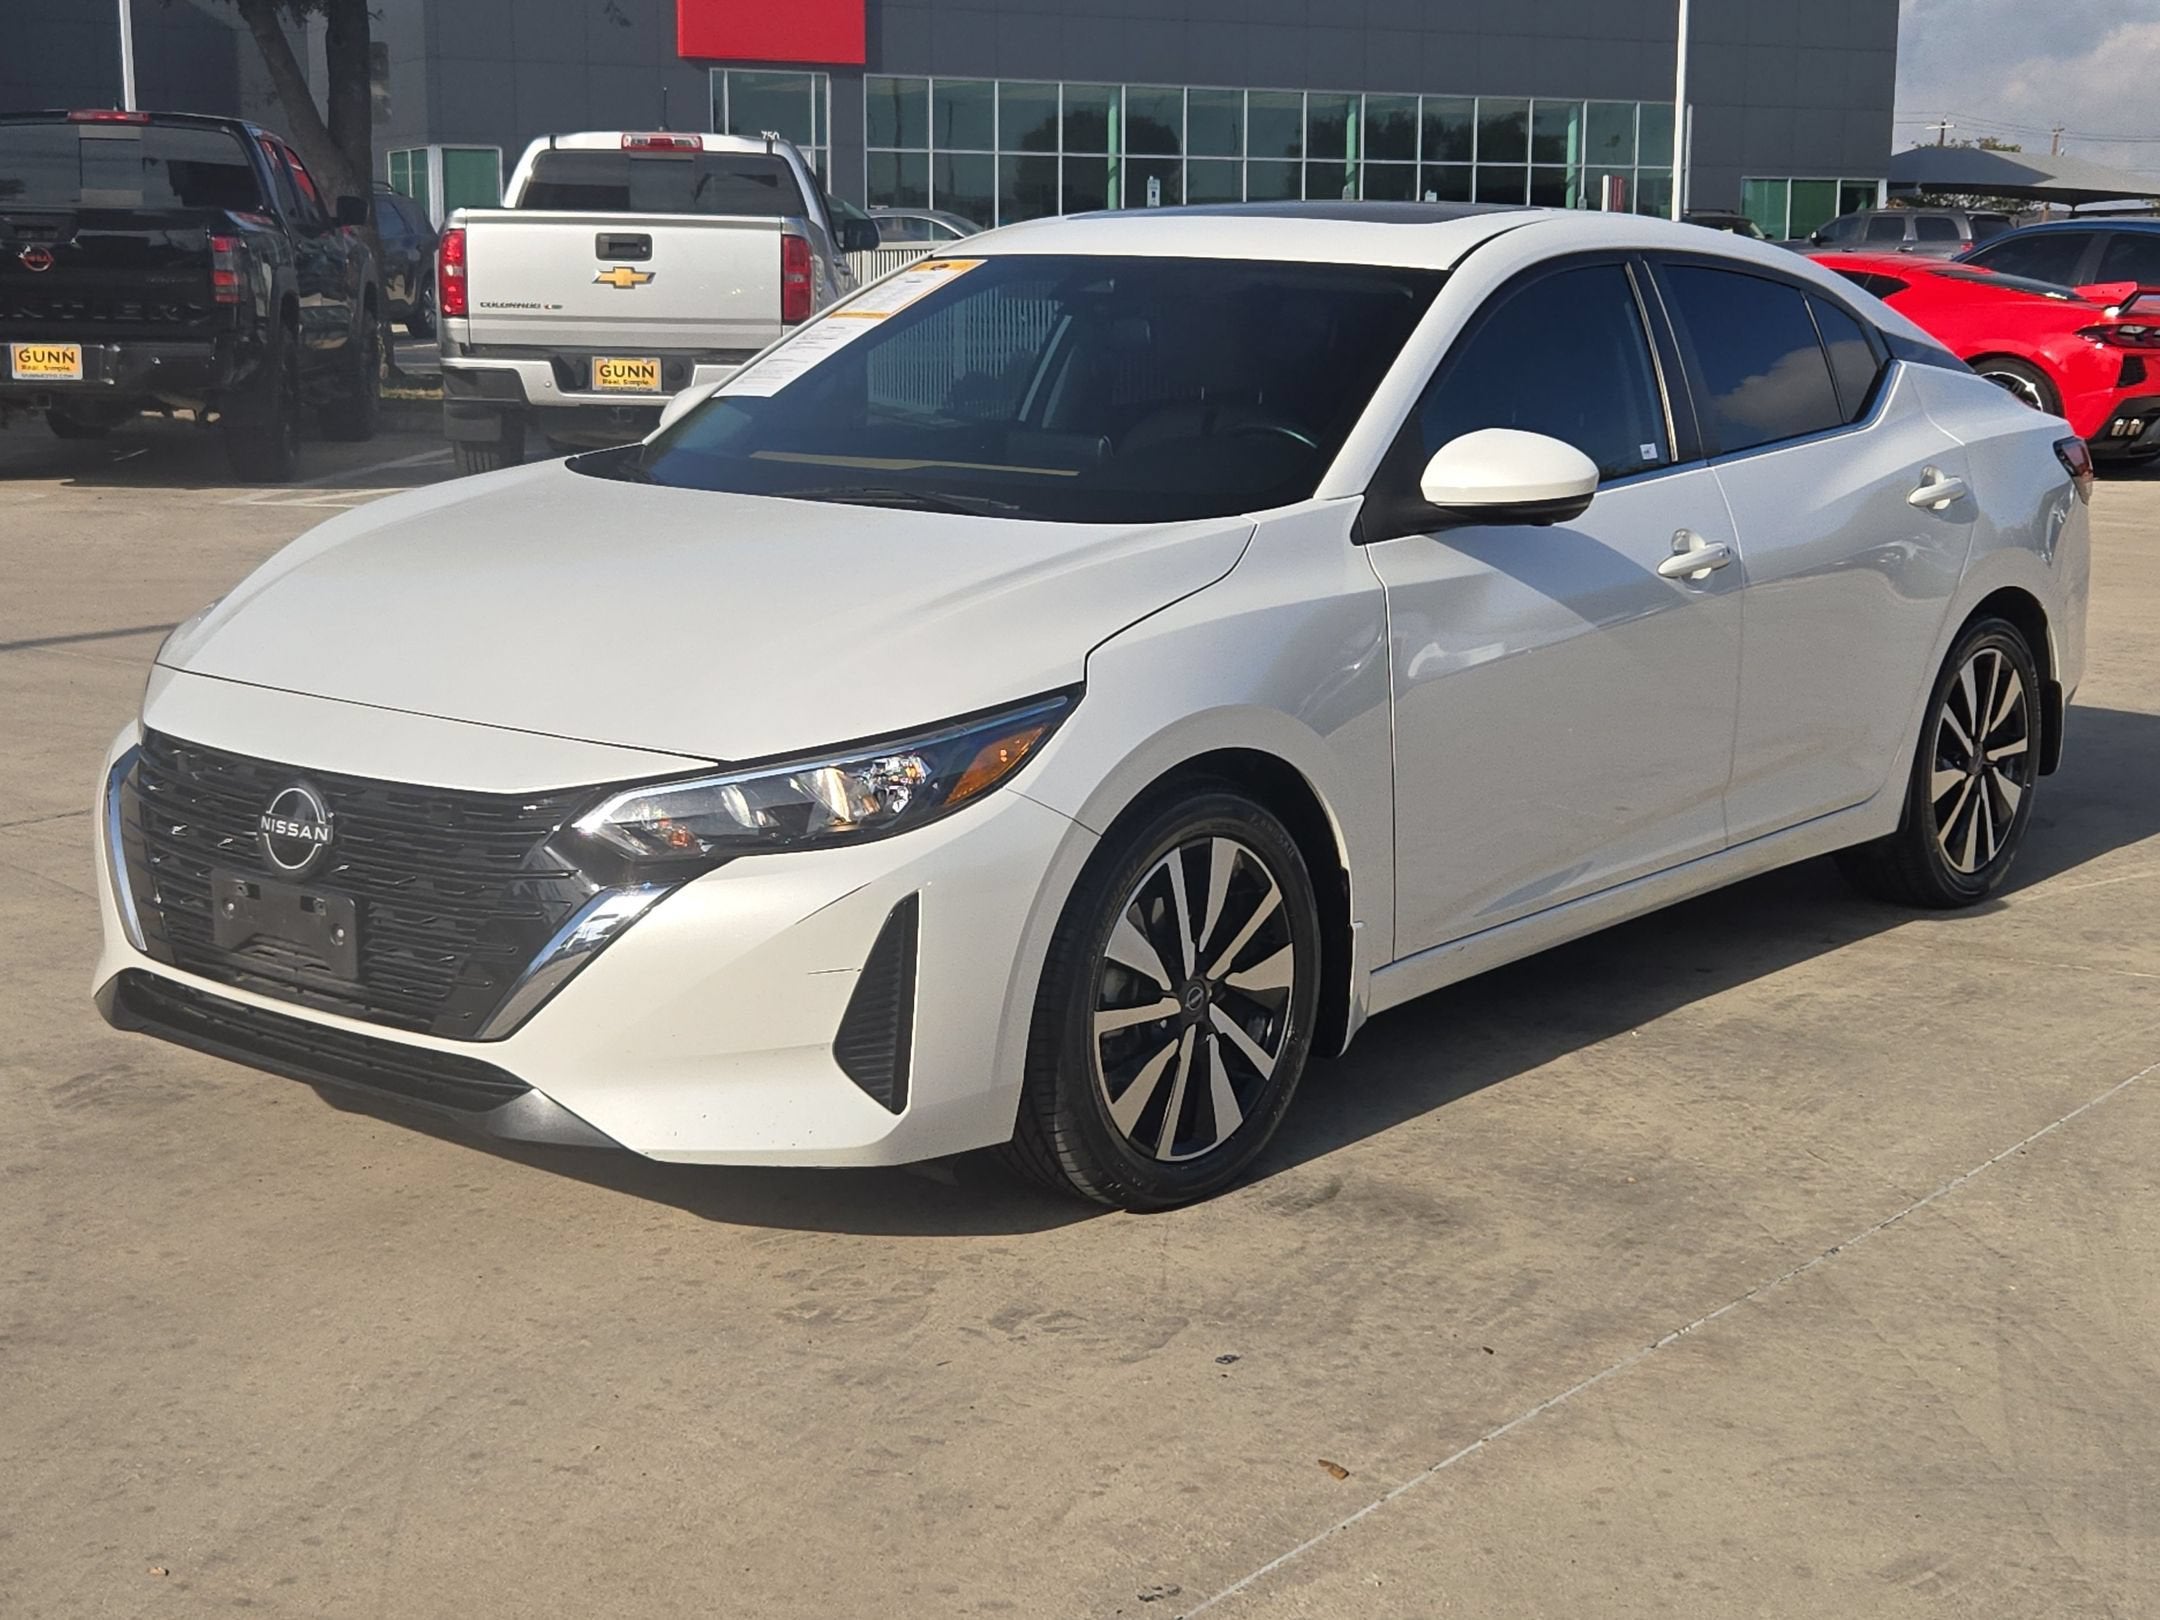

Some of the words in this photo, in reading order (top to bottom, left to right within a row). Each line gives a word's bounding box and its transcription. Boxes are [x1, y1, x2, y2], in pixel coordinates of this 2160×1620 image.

[19, 349, 75, 364] GUNN
[600, 365, 654, 378] GUNN
[260, 815, 329, 841] NISSAN
